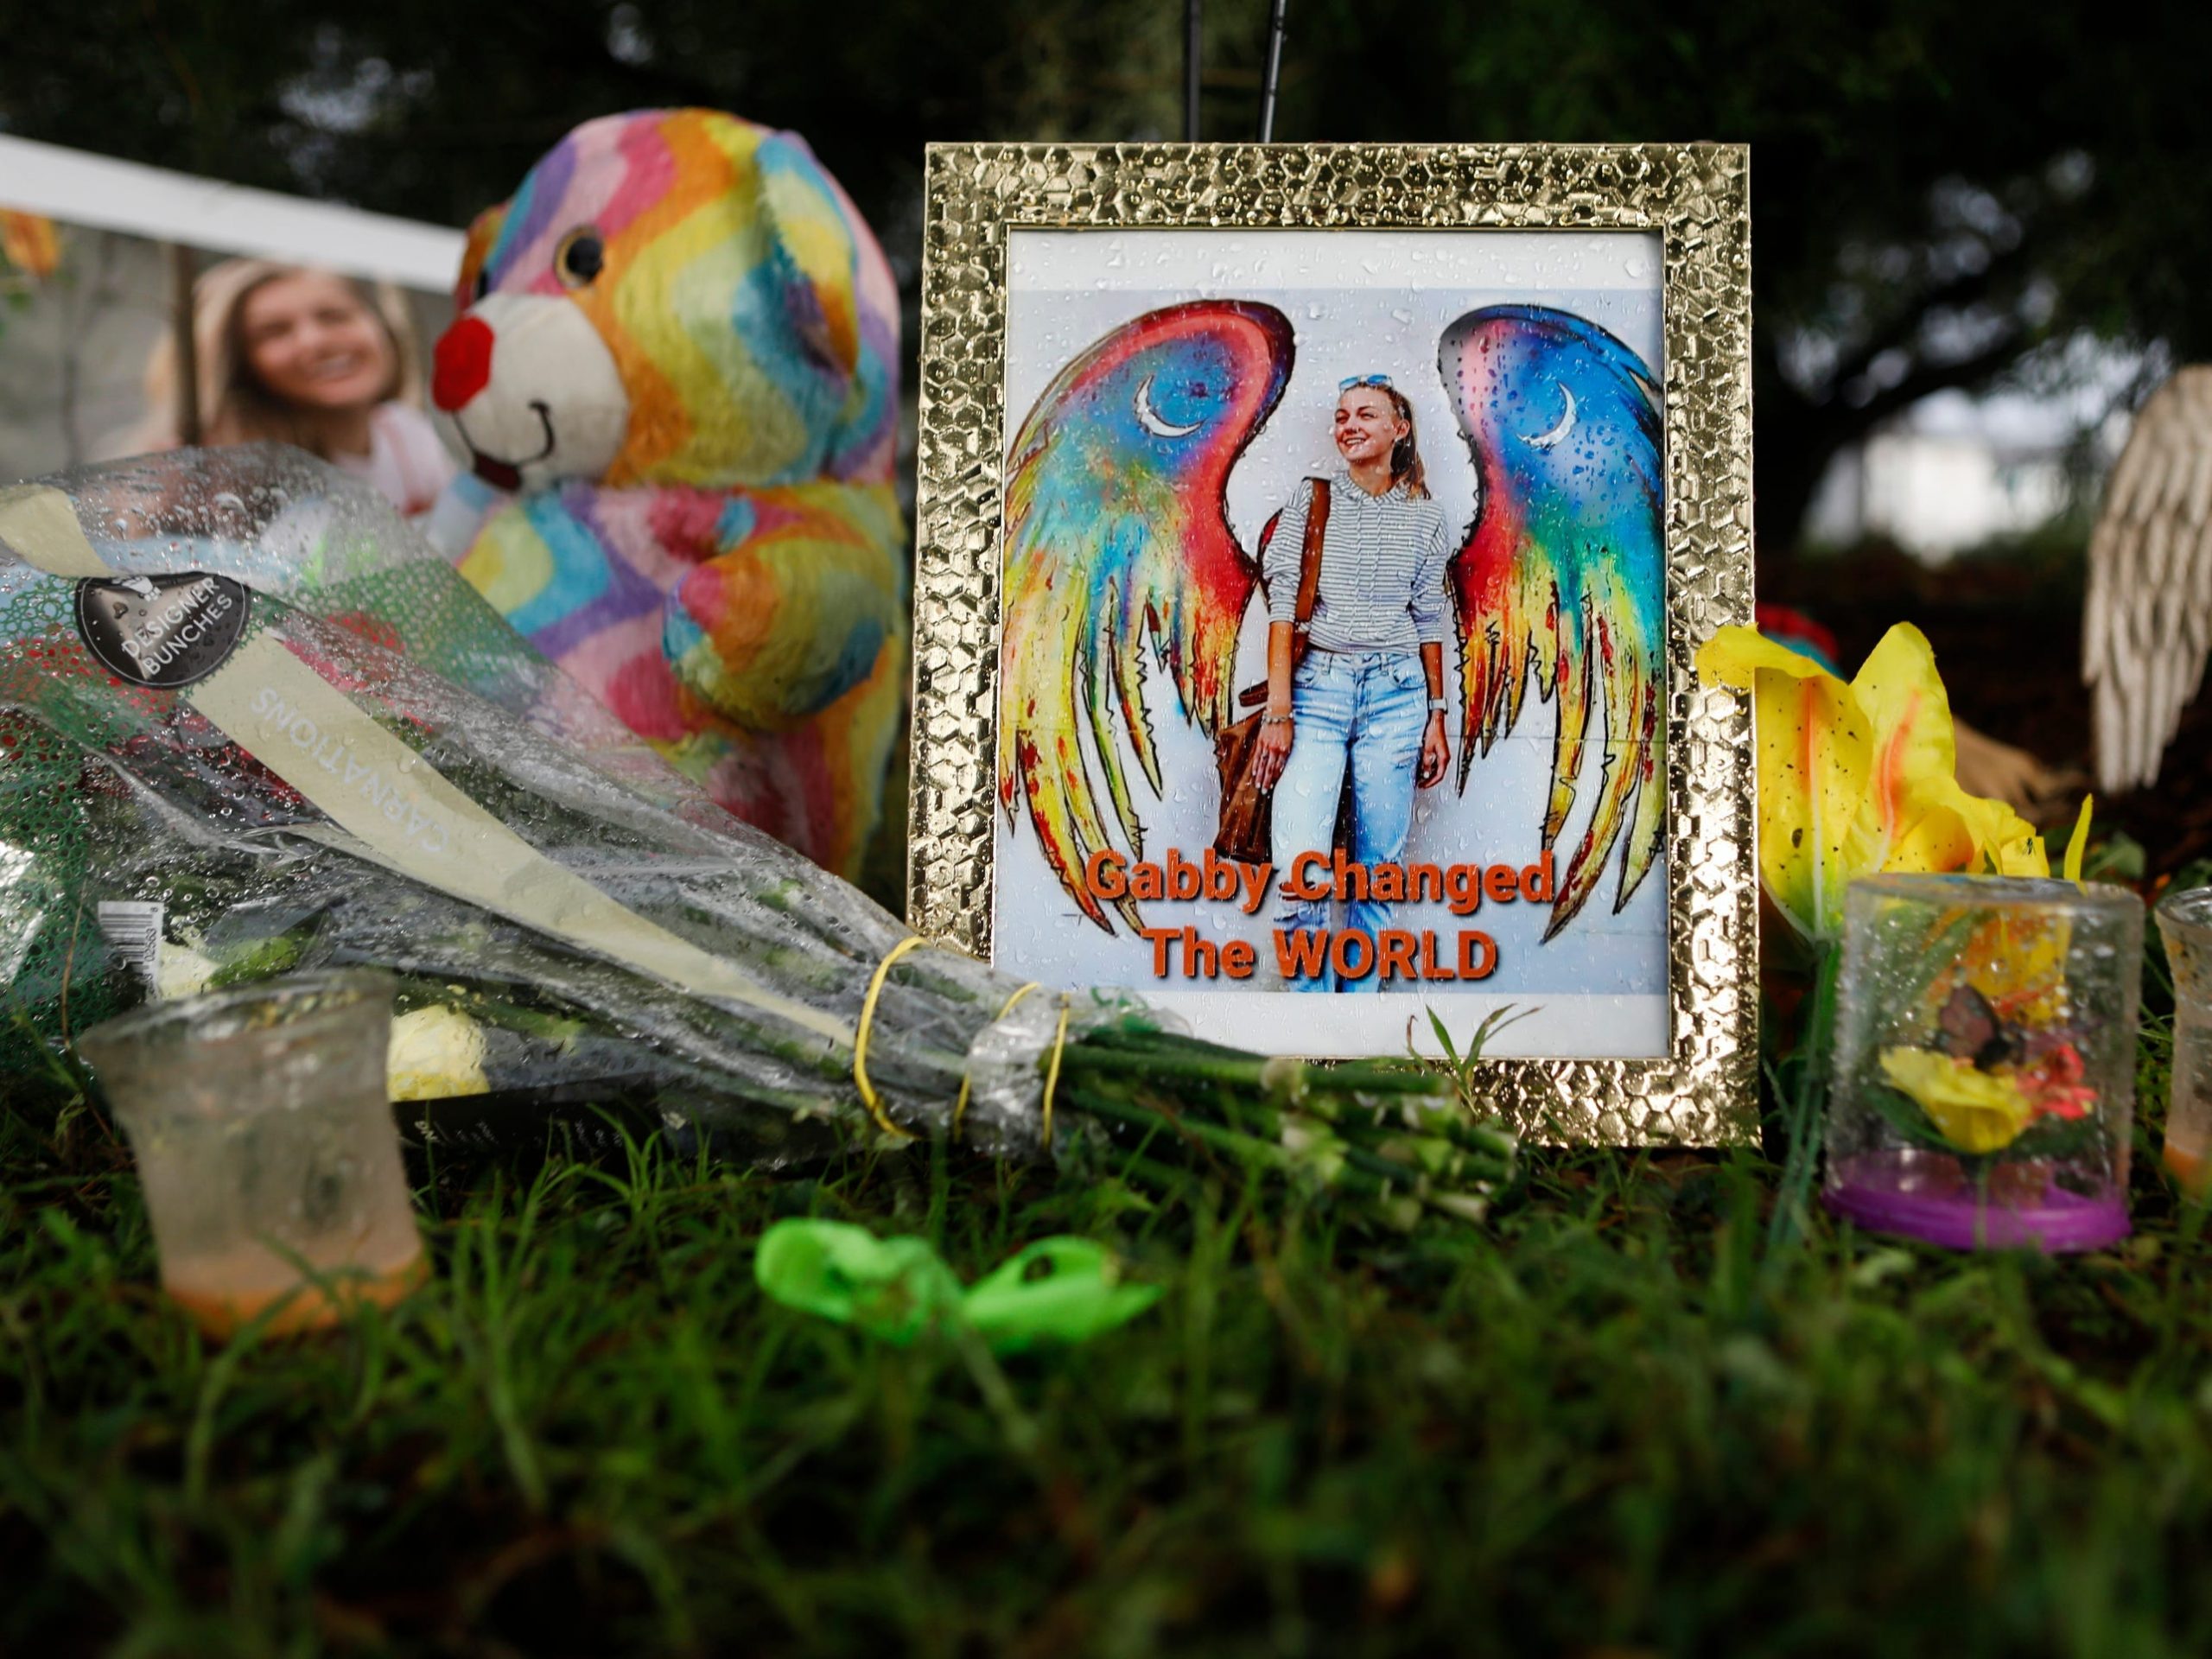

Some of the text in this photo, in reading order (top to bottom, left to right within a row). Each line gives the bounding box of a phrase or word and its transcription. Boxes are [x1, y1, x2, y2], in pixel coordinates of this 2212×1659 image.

[121, 576, 220, 658] DESIGNER
[142, 594, 232, 675] BUNCHES
[250, 687, 449, 853] CARNATIONS
[1086, 848, 1554, 914] Gabby Changed
[1141, 925, 1497, 980] The WORLD
